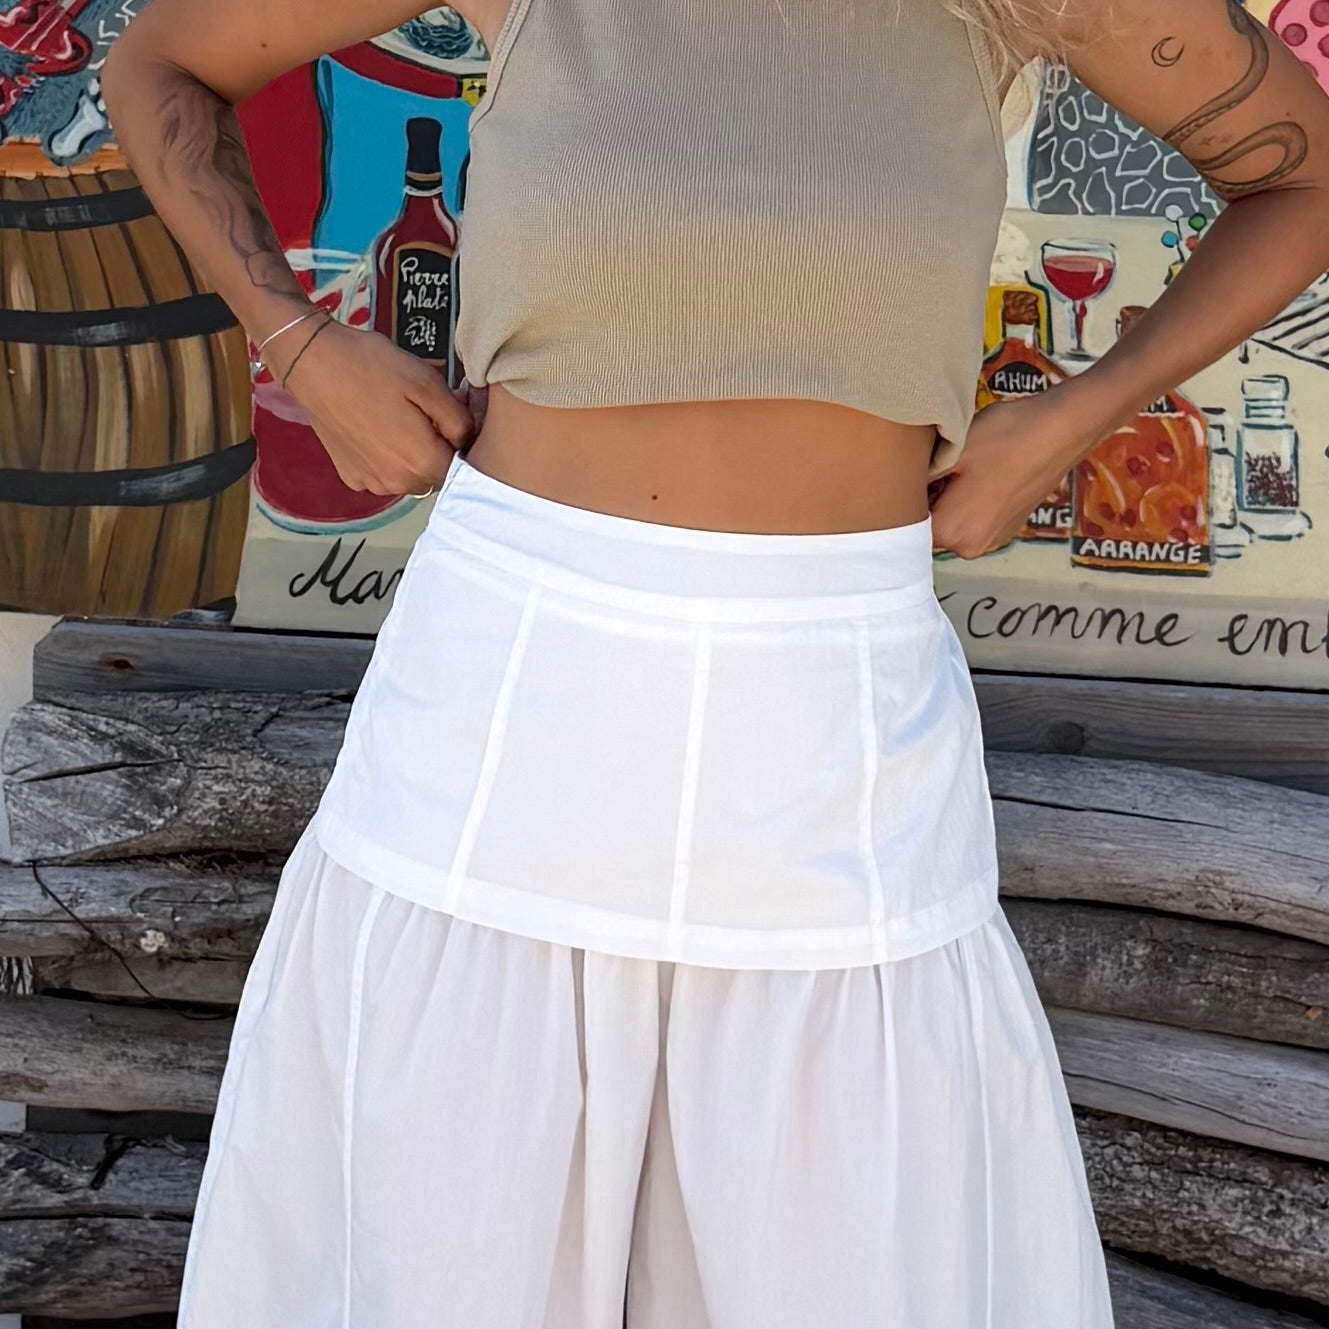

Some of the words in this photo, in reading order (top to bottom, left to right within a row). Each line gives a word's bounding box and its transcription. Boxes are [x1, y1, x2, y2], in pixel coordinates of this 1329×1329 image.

[400, 257, 448, 285] Pierre
[994, 372, 1047, 392] RHUM
[967, 596, 1197, 647] comme
